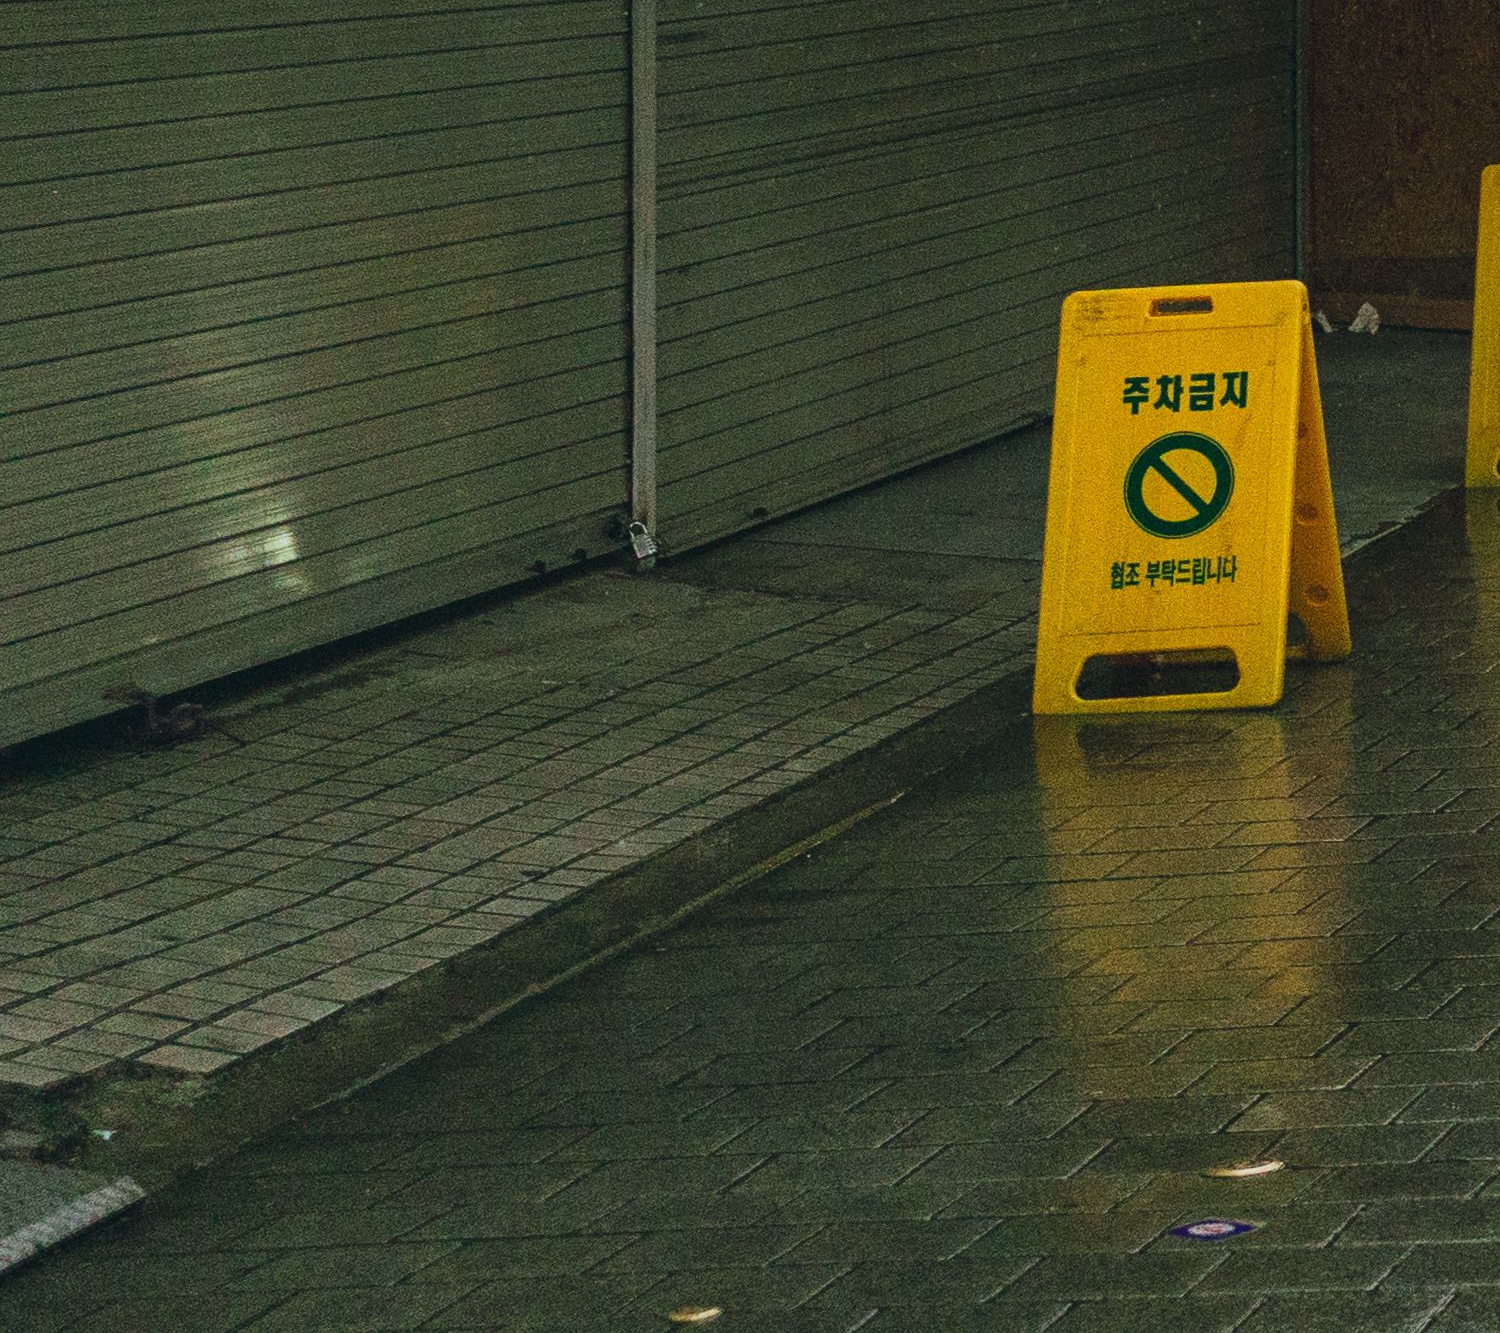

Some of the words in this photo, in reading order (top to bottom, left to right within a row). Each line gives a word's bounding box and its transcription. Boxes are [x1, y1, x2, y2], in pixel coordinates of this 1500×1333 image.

[1121, 370, 1249, 416] 주차금지
[1109, 558, 1140, 591] 협조
[1144, 554, 1239, 586] 부탁드립니다
